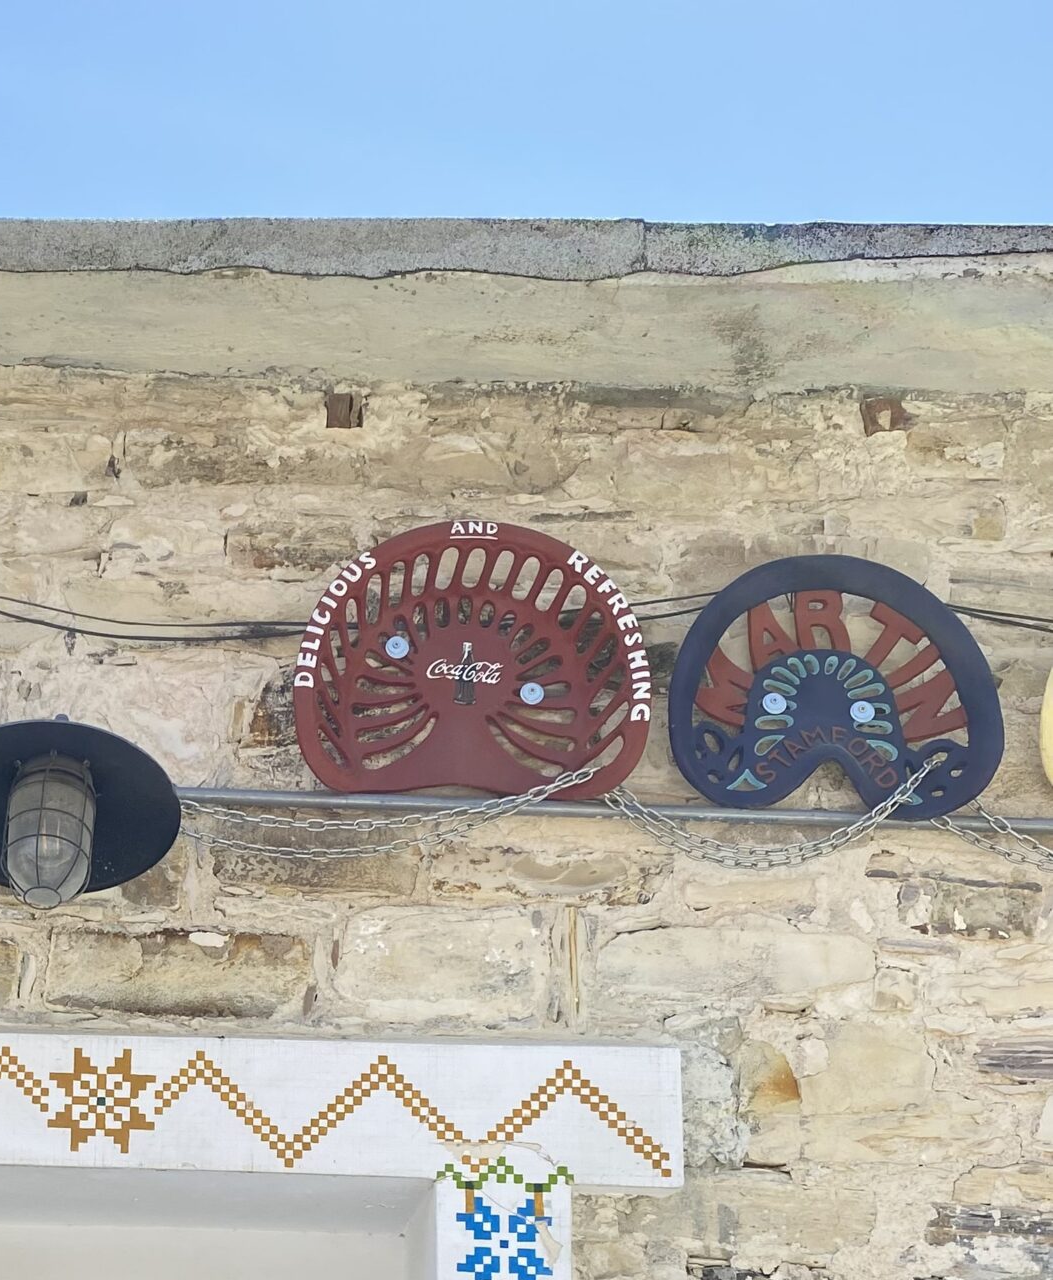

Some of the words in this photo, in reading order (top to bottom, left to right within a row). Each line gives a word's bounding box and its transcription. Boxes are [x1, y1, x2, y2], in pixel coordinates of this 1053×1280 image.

[294, 551, 377, 689] DELICIOUS
[450, 521, 499, 535] AND
[566, 550, 651, 722] REFRESHING
[426, 658, 504, 684] Coca-Cola
[694, 590, 970, 743] MARTIN
[756, 726, 899, 789] STAMFORD
